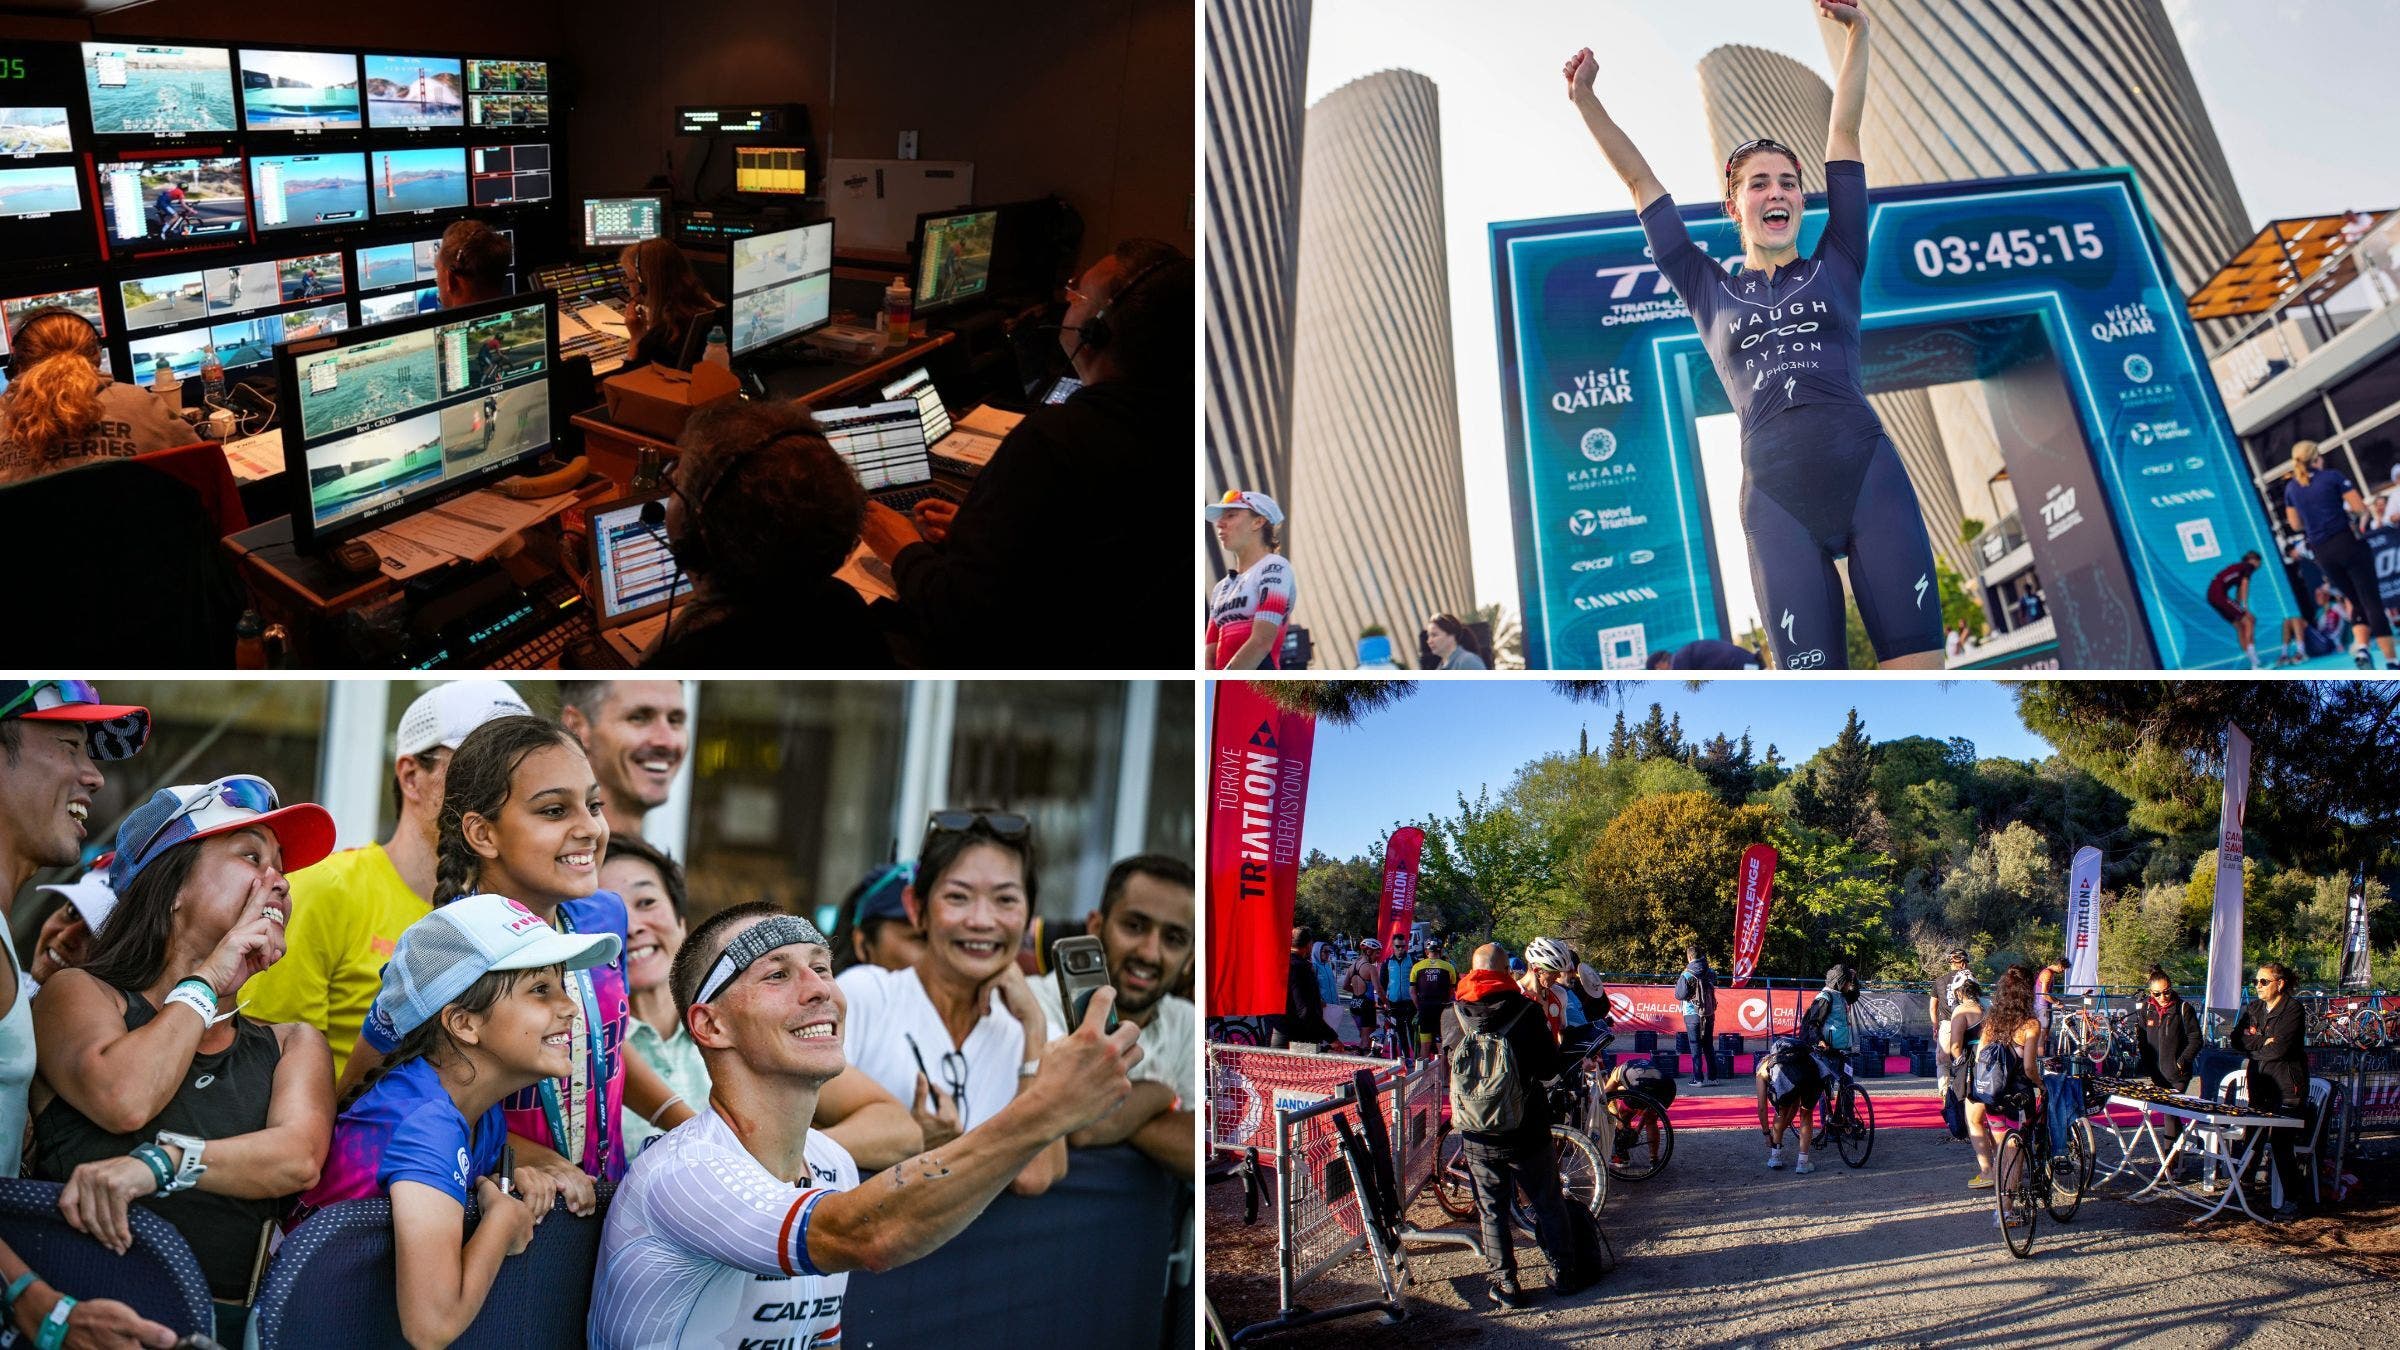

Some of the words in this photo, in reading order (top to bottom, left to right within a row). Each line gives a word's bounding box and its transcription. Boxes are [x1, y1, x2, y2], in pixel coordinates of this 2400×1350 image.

[1913, 222, 2103, 278] 03:45:15
[1611, 299, 1686, 314] TRIATHLO
[1729, 301, 1827, 334] WAUGH
[2104, 302, 2150, 322] visit
[1741, 321, 1819, 349] orca
[2091, 318, 2156, 342] QATAR
[1746, 342, 1821, 370] RYZON
[1573, 367, 1630, 389] visit
[1552, 384, 1634, 413] QATAR
[356, 421, 370, 433] Red
[374, 415, 396, 429] CRAIG
[501, 455, 519, 467] HUGH
[1567, 462, 1636, 482] KATARA
[383, 498, 404, 512] HUGH
[1597, 506, 1632, 519] World
[1600, 515, 1648, 530] Triathlon
[1574, 587, 1658, 611] CANYON
[1790, 652, 1821, 667] PTO
[1218, 746, 1242, 811] TÜRKİYE
[1274, 759, 1304, 865] FEDERASYONU
[1740, 857, 1760, 954] CHALLENGE
[1746, 895, 1765, 953] FAMILY
[1636, 1003, 1682, 1013] CHALLEN
